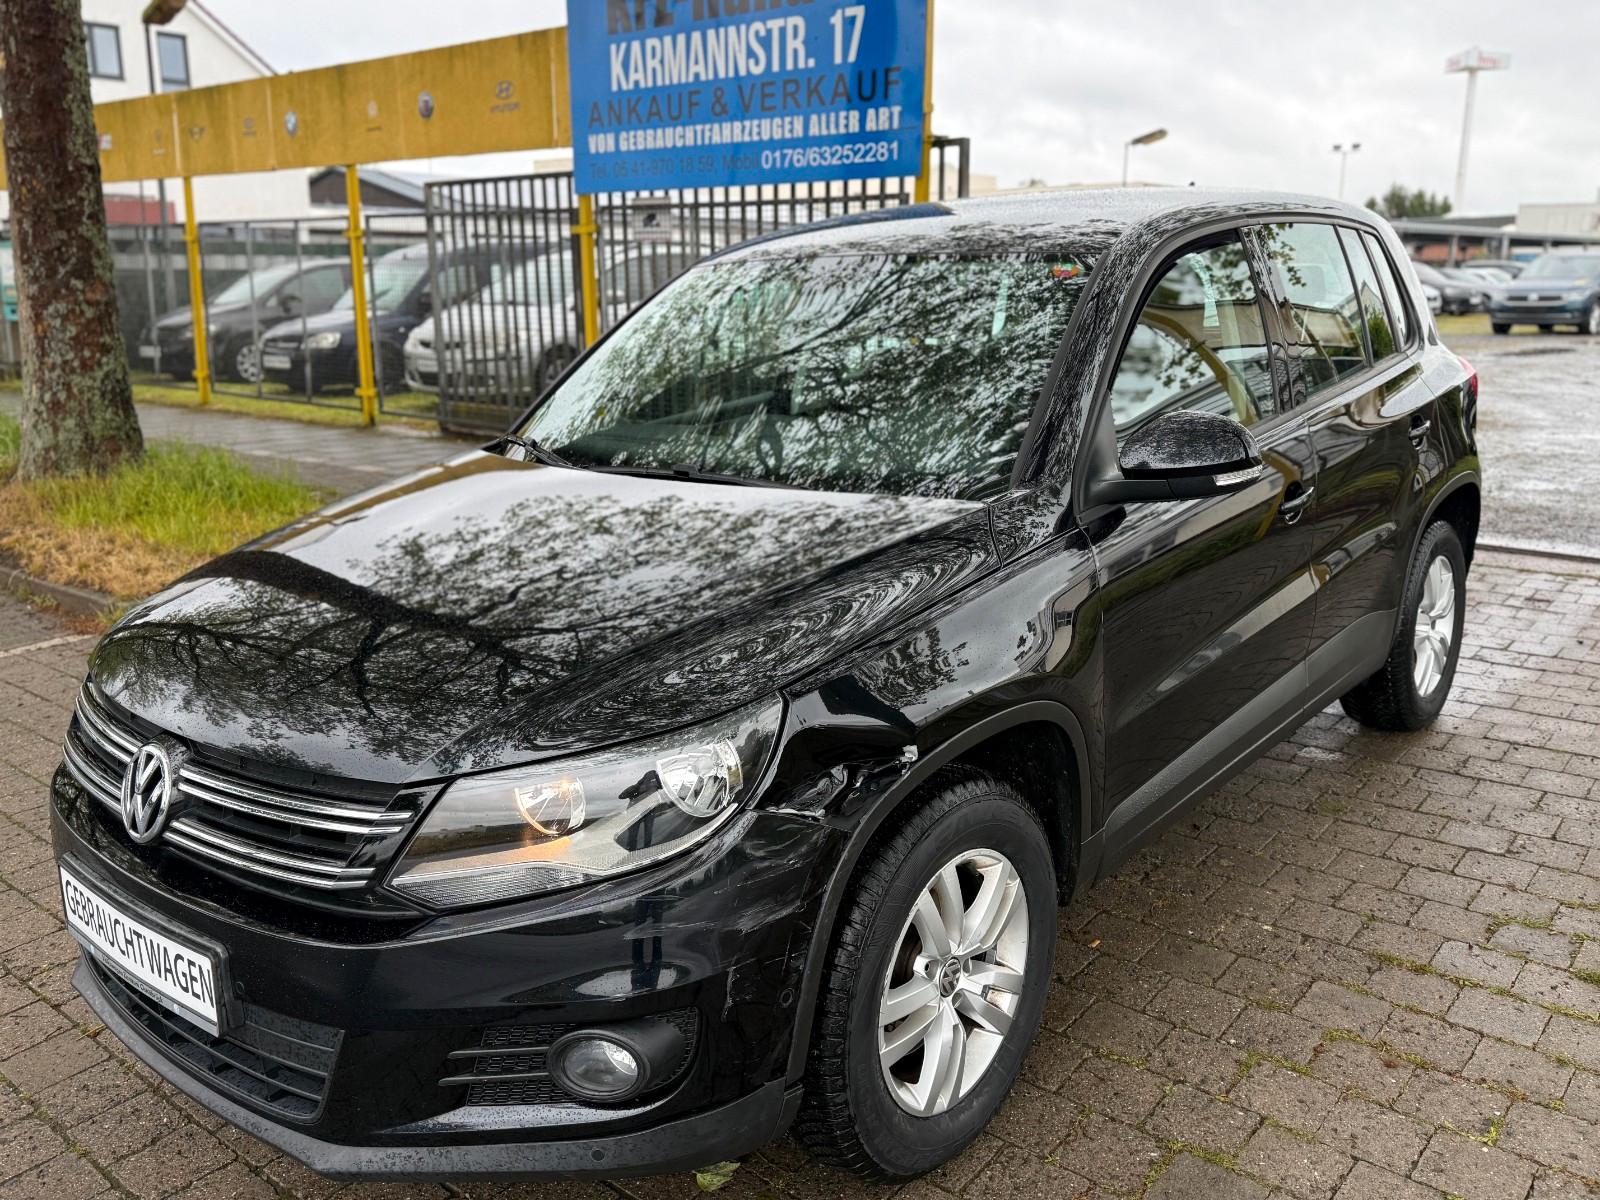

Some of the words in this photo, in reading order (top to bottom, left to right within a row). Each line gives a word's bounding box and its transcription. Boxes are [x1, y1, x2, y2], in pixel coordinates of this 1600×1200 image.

[610, 15, 816, 92] KARMANNSTR.
[830, 5, 866, 65] 17
[588, 89, 702, 129] ANKAUF
[711, 86, 729, 118] &
[738, 66, 902, 114] VERKAUF
[588, 132, 616, 154] VON
[619, 115, 804, 152] GEBRAUCHTFAHRZEUGEN
[808, 109, 860, 137] ALLER
[866, 105, 902, 132] ART
[761, 140, 899, 169] 0176/63252281
[65, 879, 215, 1009] GEBRAUCHTWAGEN
